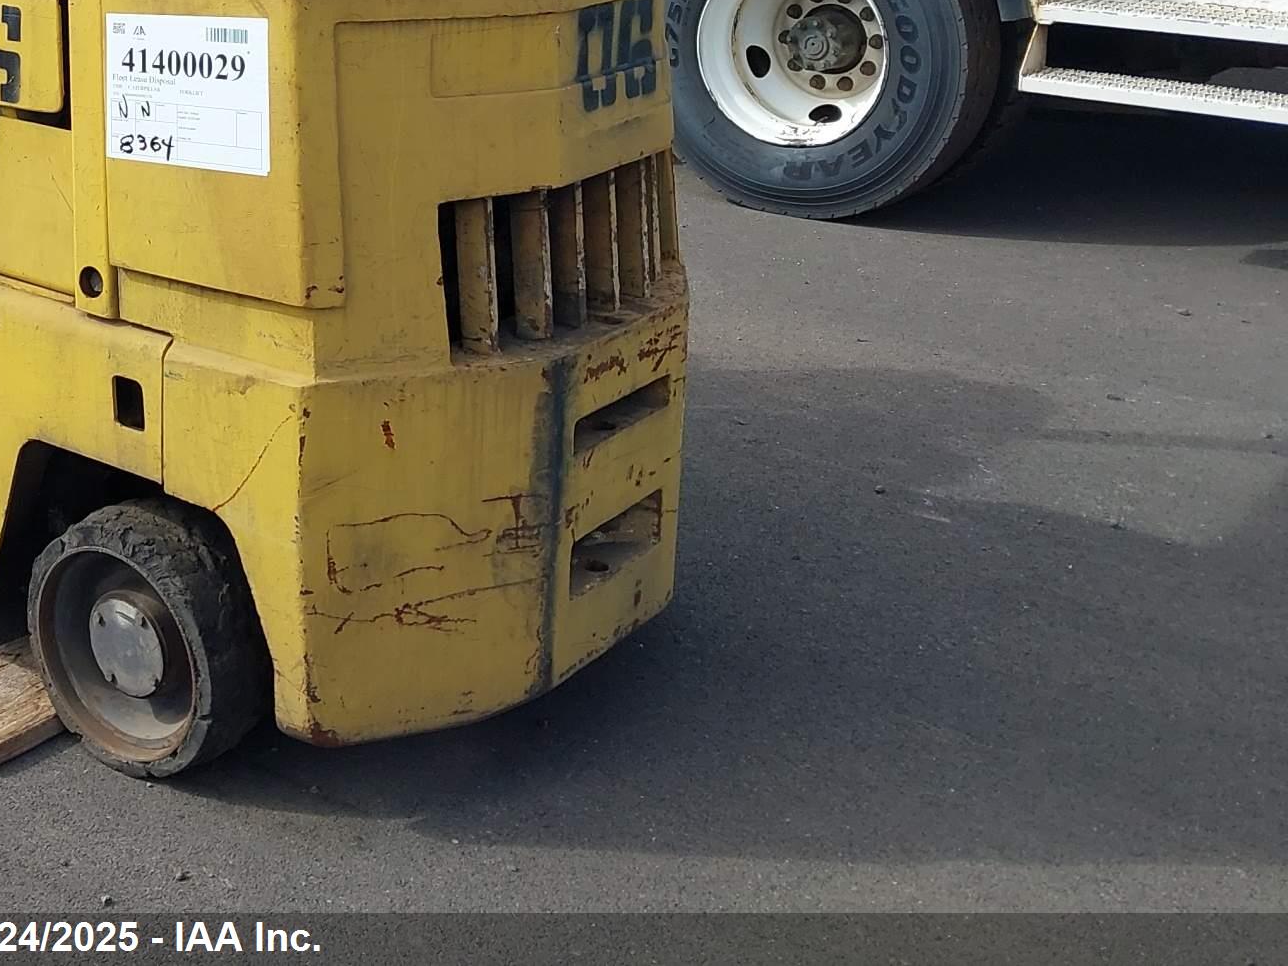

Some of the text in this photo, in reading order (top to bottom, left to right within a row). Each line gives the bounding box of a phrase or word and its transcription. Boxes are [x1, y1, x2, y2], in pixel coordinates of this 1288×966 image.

[121, 46, 246, 82] 41400029
[149, 75, 176, 86] Disposal
[119, 134, 175, 161] 8364
